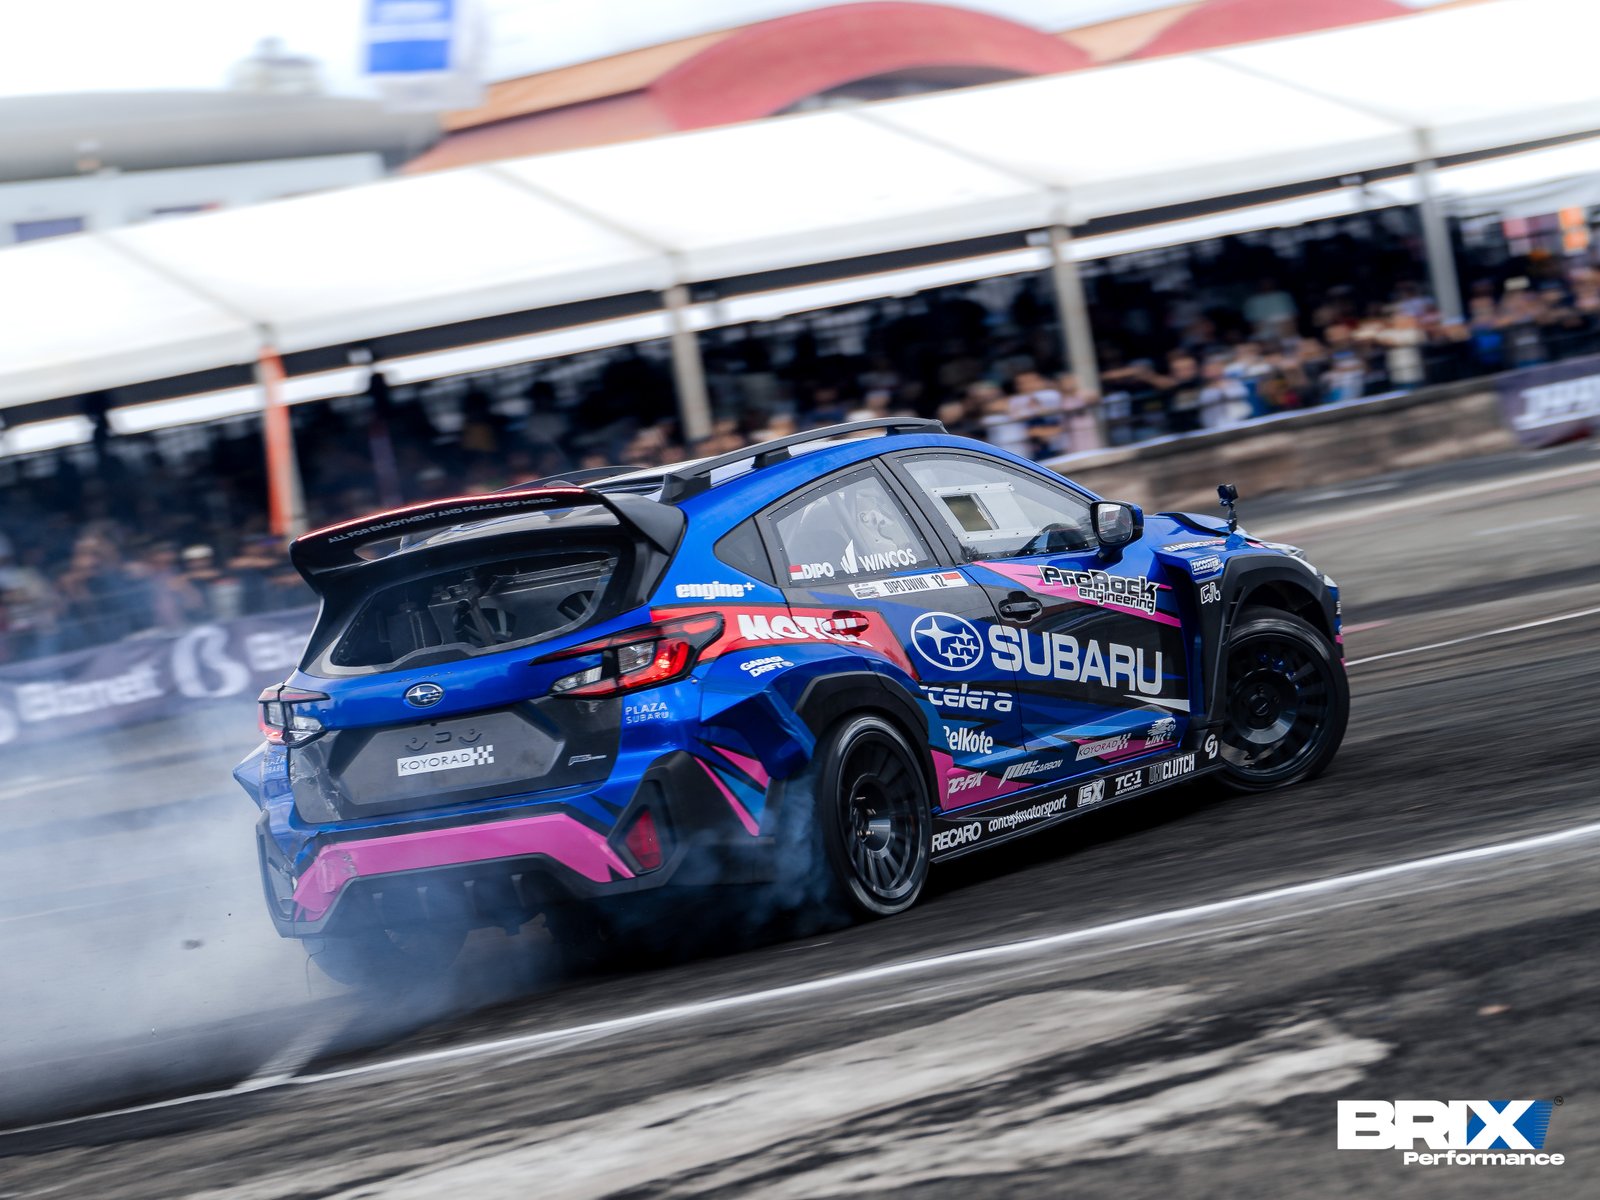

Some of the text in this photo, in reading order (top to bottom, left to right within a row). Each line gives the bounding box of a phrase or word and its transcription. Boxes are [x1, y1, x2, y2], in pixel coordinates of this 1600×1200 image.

[800, 561, 835, 579] DIPO
[859, 548, 917, 572] WINCOS
[883, 581, 907, 594] DIPO
[904, 577, 930, 591] DWIKI
[931, 574, 947, 587] 12
[1037, 564, 1161, 602] ProRock
[1078, 585, 1157, 615] engineering
[988, 624, 1163, 696] SUBARU
[625, 702, 667, 715] PLAZA
[919, 683, 1013, 712] celera
[625, 711, 670, 724] SUBARU
[1078, 740, 1118, 757] KOYORAD
[400, 753, 472, 771] KOYORAD
[1115, 770, 1142, 789] TC-1
[988, 794, 1067, 833] conceptmotorsport
[931, 821, 982, 852] RECARO
